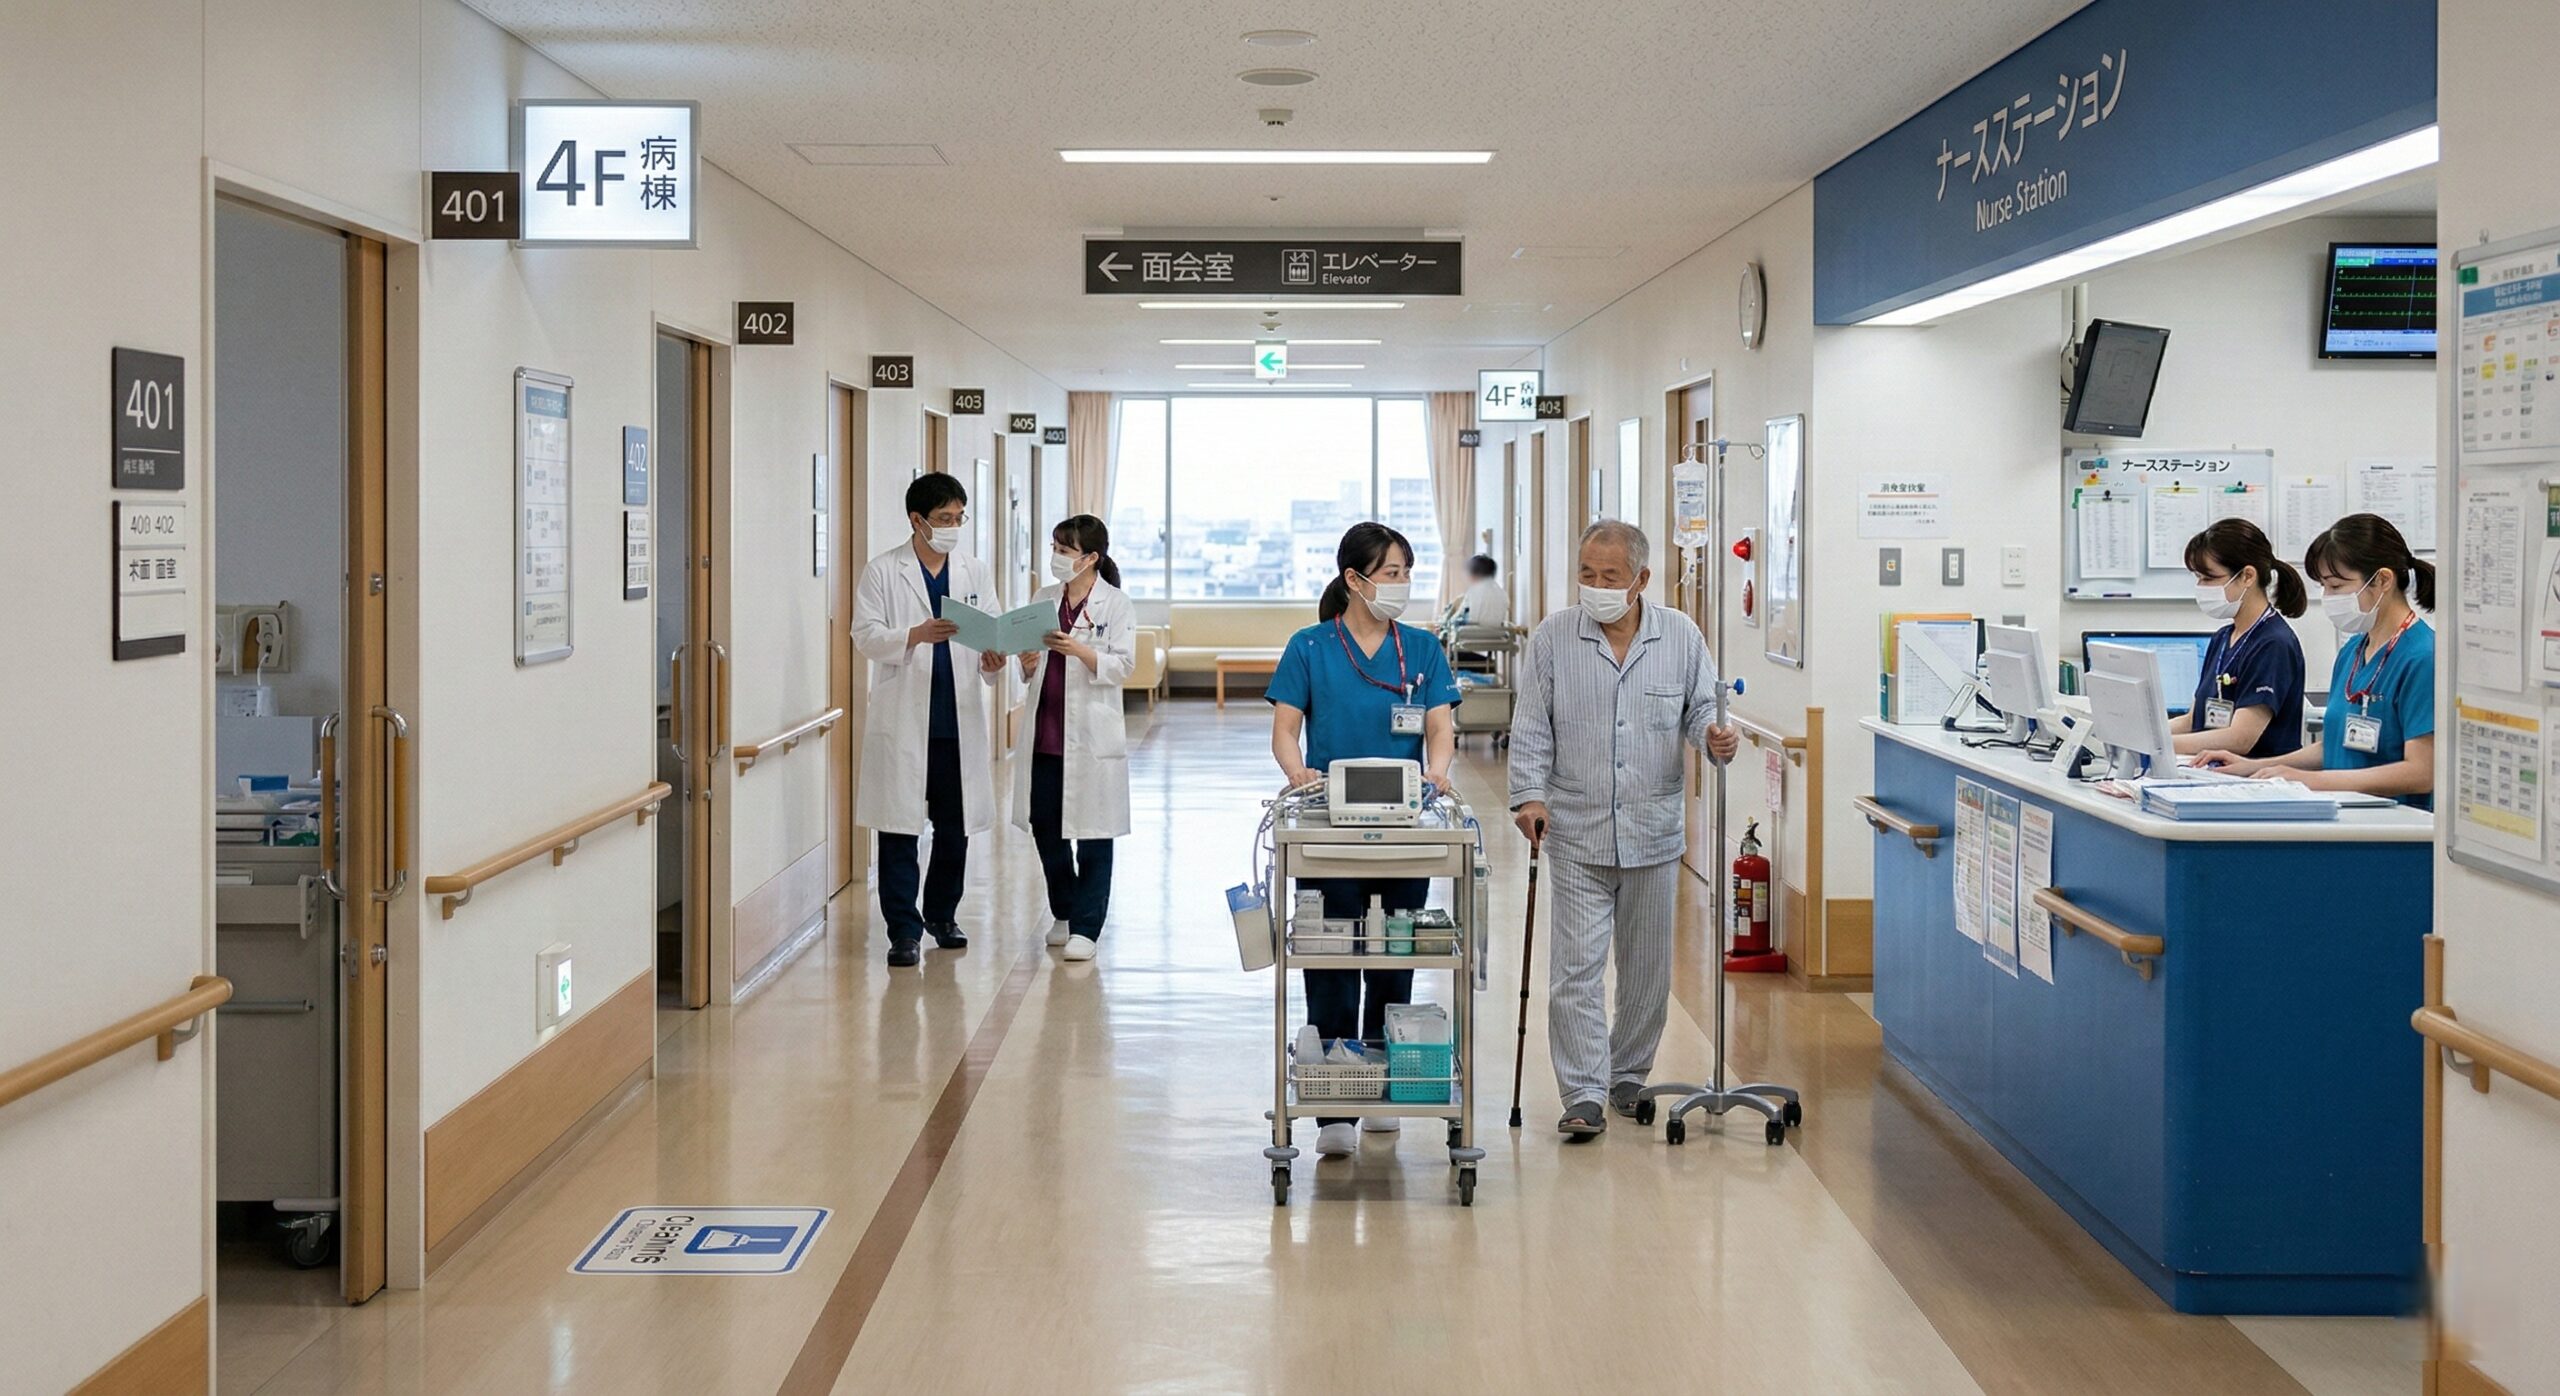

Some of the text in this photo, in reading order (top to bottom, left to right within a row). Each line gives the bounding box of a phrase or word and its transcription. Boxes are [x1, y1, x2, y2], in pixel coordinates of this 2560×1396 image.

[1937, 48, 2127, 202] ナースステーション
[536, 135, 678, 210] 4F 病棟
[441, 190, 505, 222] 401
[1976, 167, 2068, 233] Nurse Station
[1141, 251, 1235, 283] 面会室
[1322, 252, 1437, 272] エレベーター
[1322, 273, 1371, 286] Elevator
[743, 312, 788, 335] 402
[875, 363, 910, 382] 403
[125, 379, 174, 431] 401
[955, 395, 982, 409] 403
[1485, 384, 1517, 407] 4F
[627, 442, 647, 473] 402
[2121, 458, 2231, 473] ナースステーション
